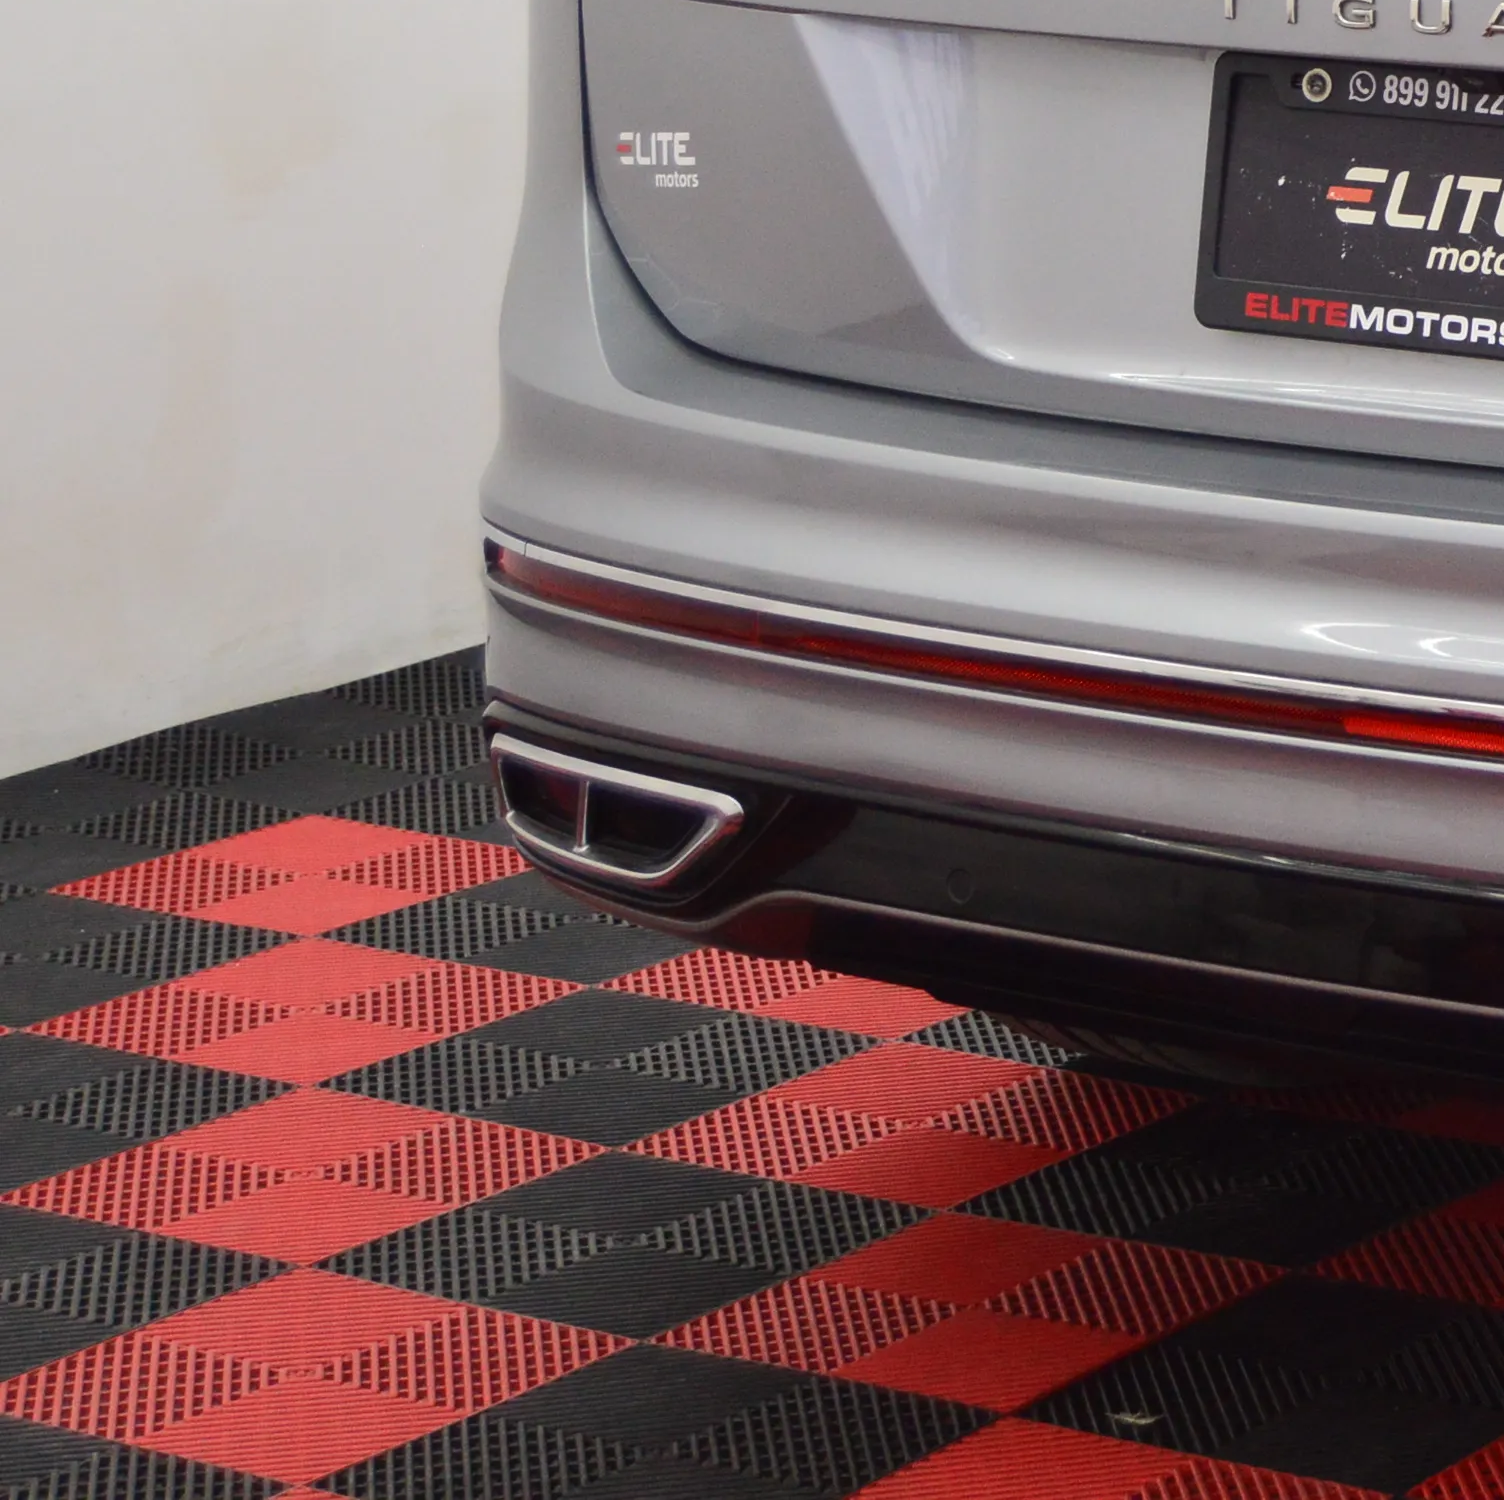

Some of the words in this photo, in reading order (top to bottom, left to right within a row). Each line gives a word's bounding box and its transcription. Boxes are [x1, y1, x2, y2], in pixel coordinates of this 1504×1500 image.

[1382, 74, 1431, 110] 899
[1435, 78, 1468, 113] 911
[616, 131, 697, 166] ELITE
[655, 171, 700, 188] motors
